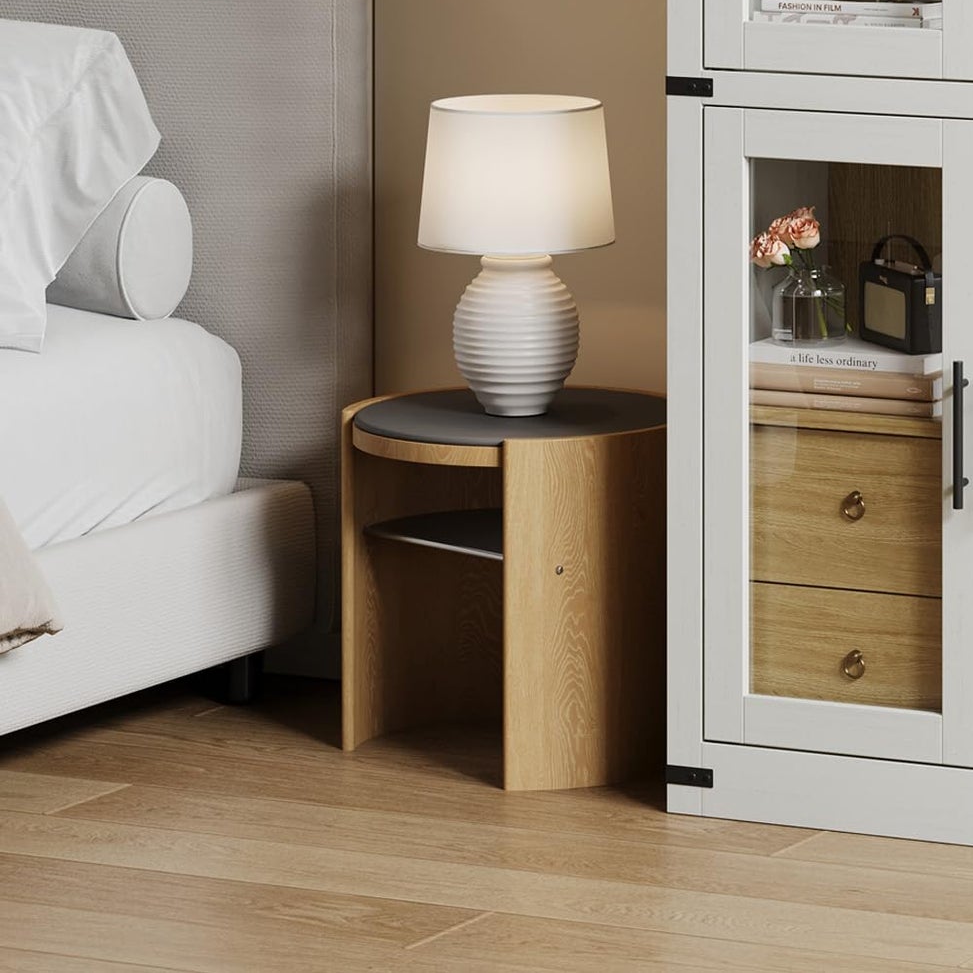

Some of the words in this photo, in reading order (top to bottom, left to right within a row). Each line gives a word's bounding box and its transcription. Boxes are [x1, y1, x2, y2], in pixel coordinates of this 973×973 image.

[778, 2, 812, 11] FASHION
[813, 3, 822, 11] IN
[823, 4, 842, 12] FILM
[798, 353, 813, 363] life
[816, 354, 833, 365] less
[836, 355, 878, 370] ordinary
